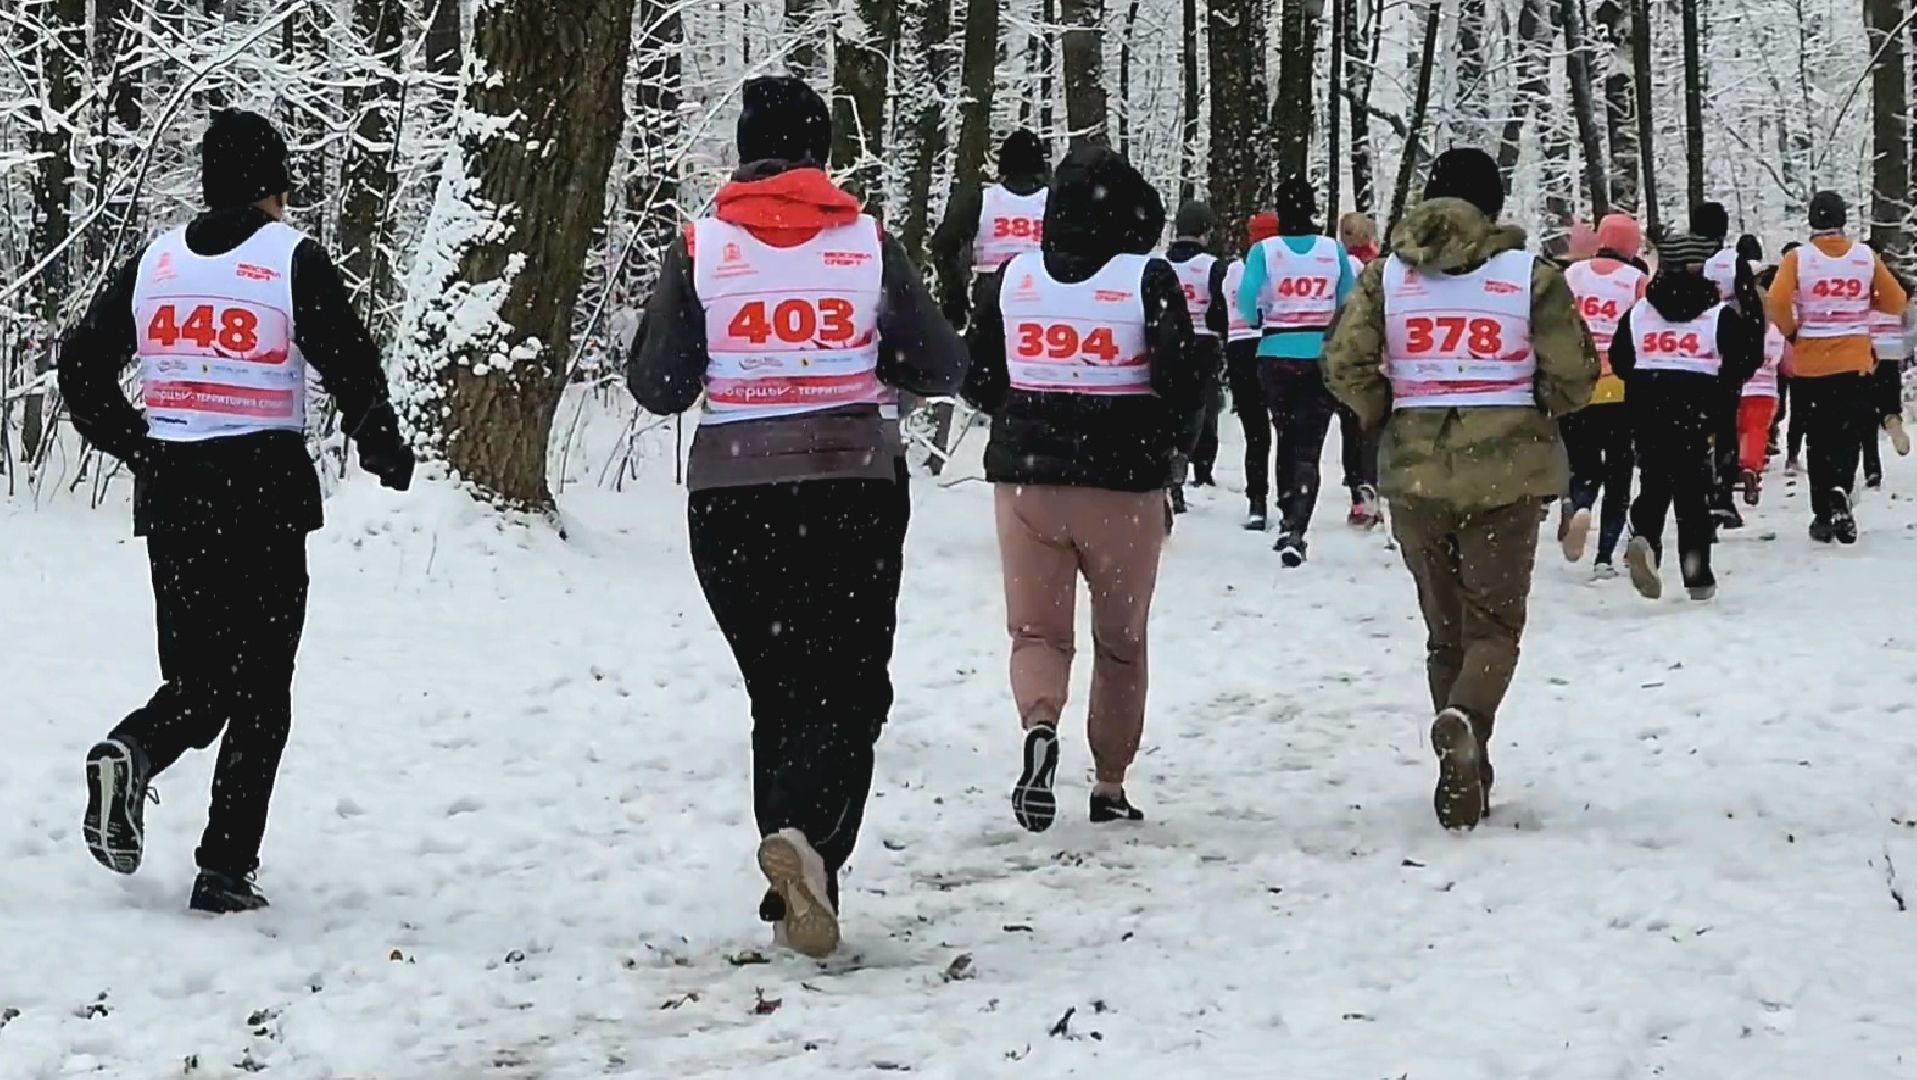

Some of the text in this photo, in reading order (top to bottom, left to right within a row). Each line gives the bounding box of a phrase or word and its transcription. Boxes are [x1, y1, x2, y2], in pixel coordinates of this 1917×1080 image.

[1278, 277, 1328, 298] 407
[1813, 278, 1862, 298] 429
[147, 304, 258, 353] 448
[728, 298, 855, 344] 403
[1406, 317, 1502, 354] 378
[1017, 322, 1119, 360] 394
